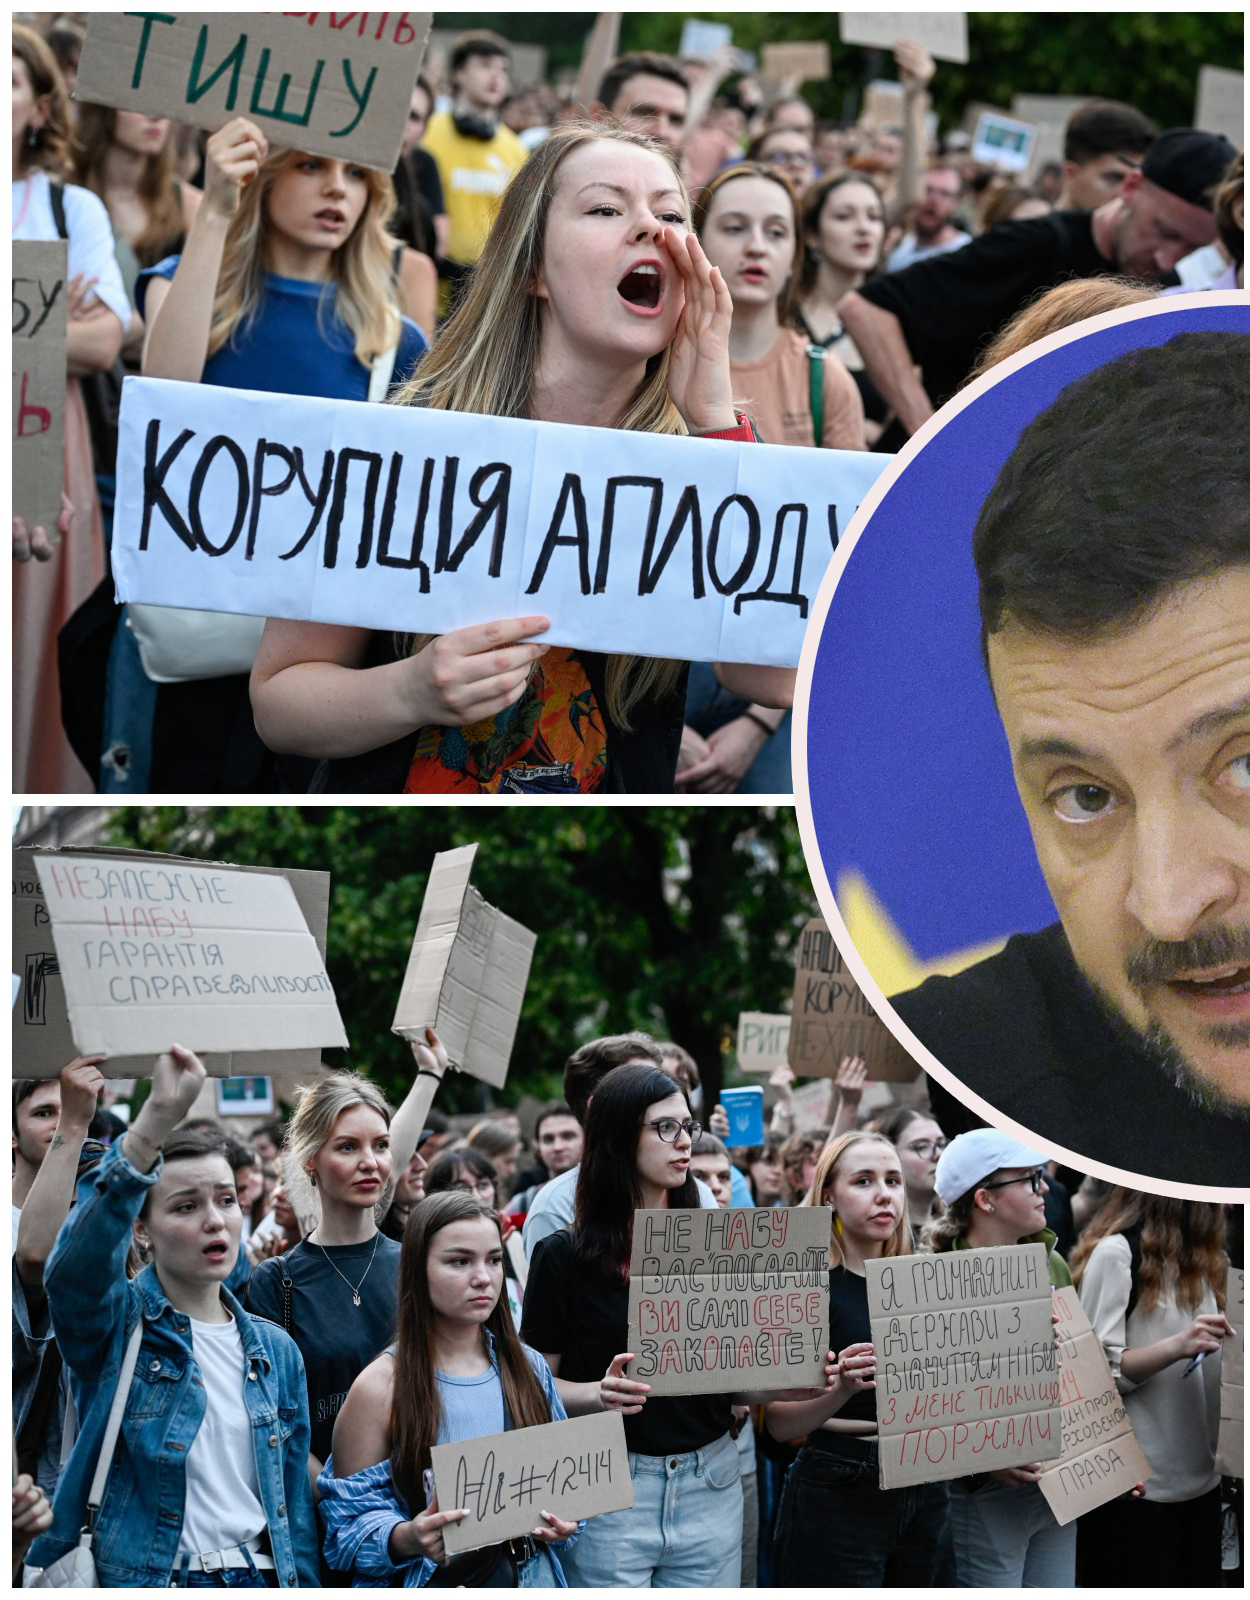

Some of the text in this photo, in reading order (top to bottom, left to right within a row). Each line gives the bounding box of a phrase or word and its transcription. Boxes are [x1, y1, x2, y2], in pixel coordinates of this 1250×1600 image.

[124, 12, 378, 137] ТИШУ
[138, 418, 512, 595] КОРУПЦІЯ
[102, 905, 194, 939] НАБУ
[83, 940, 224, 969] ГАРАНТІЯ
[645, 1209, 790, 1254] НЕ НАБУ
[641, 1256, 705, 1295] ВАС
[880, 1254, 1039, 1311] Я ГРОМАДЯНИН
[638, 1292, 821, 1337] ВИ САМІ СЕБЕ
[883, 1308, 1000, 1357] ДЕРЖАВИ
[905, 1389, 966, 1425] МЕНЕ
[899, 1413, 1052, 1467] ПОРЖАЛИ
[1058, 1448, 1125, 1496] ПРАВА
